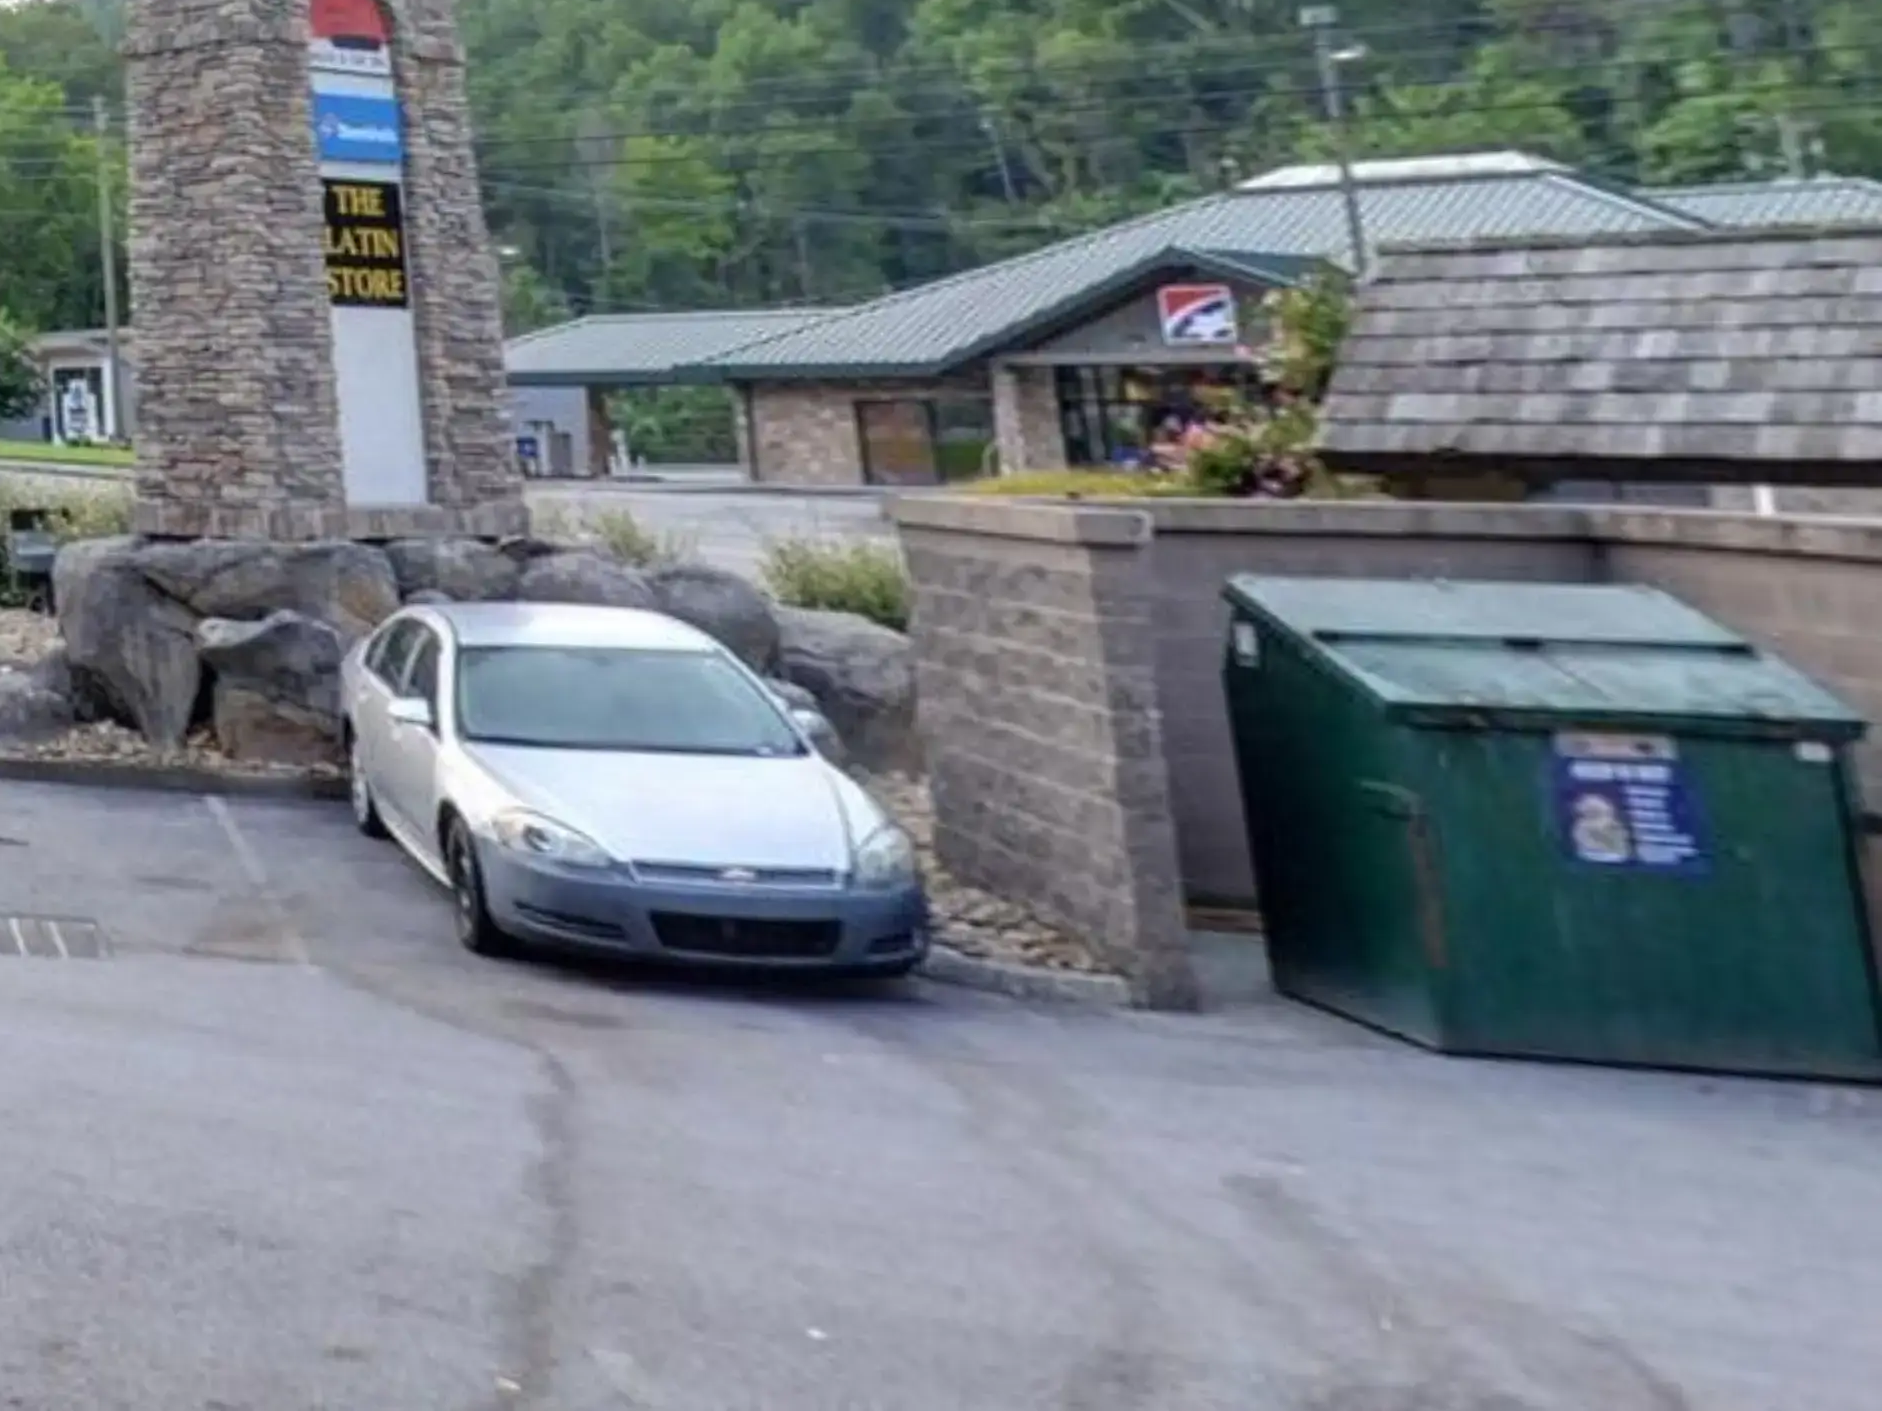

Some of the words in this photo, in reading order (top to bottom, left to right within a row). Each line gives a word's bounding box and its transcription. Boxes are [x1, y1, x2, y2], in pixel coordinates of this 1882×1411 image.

[332, 185, 385, 217] THE
[322, 225, 399, 258] LATIN
[327, 267, 405, 299] STORE
